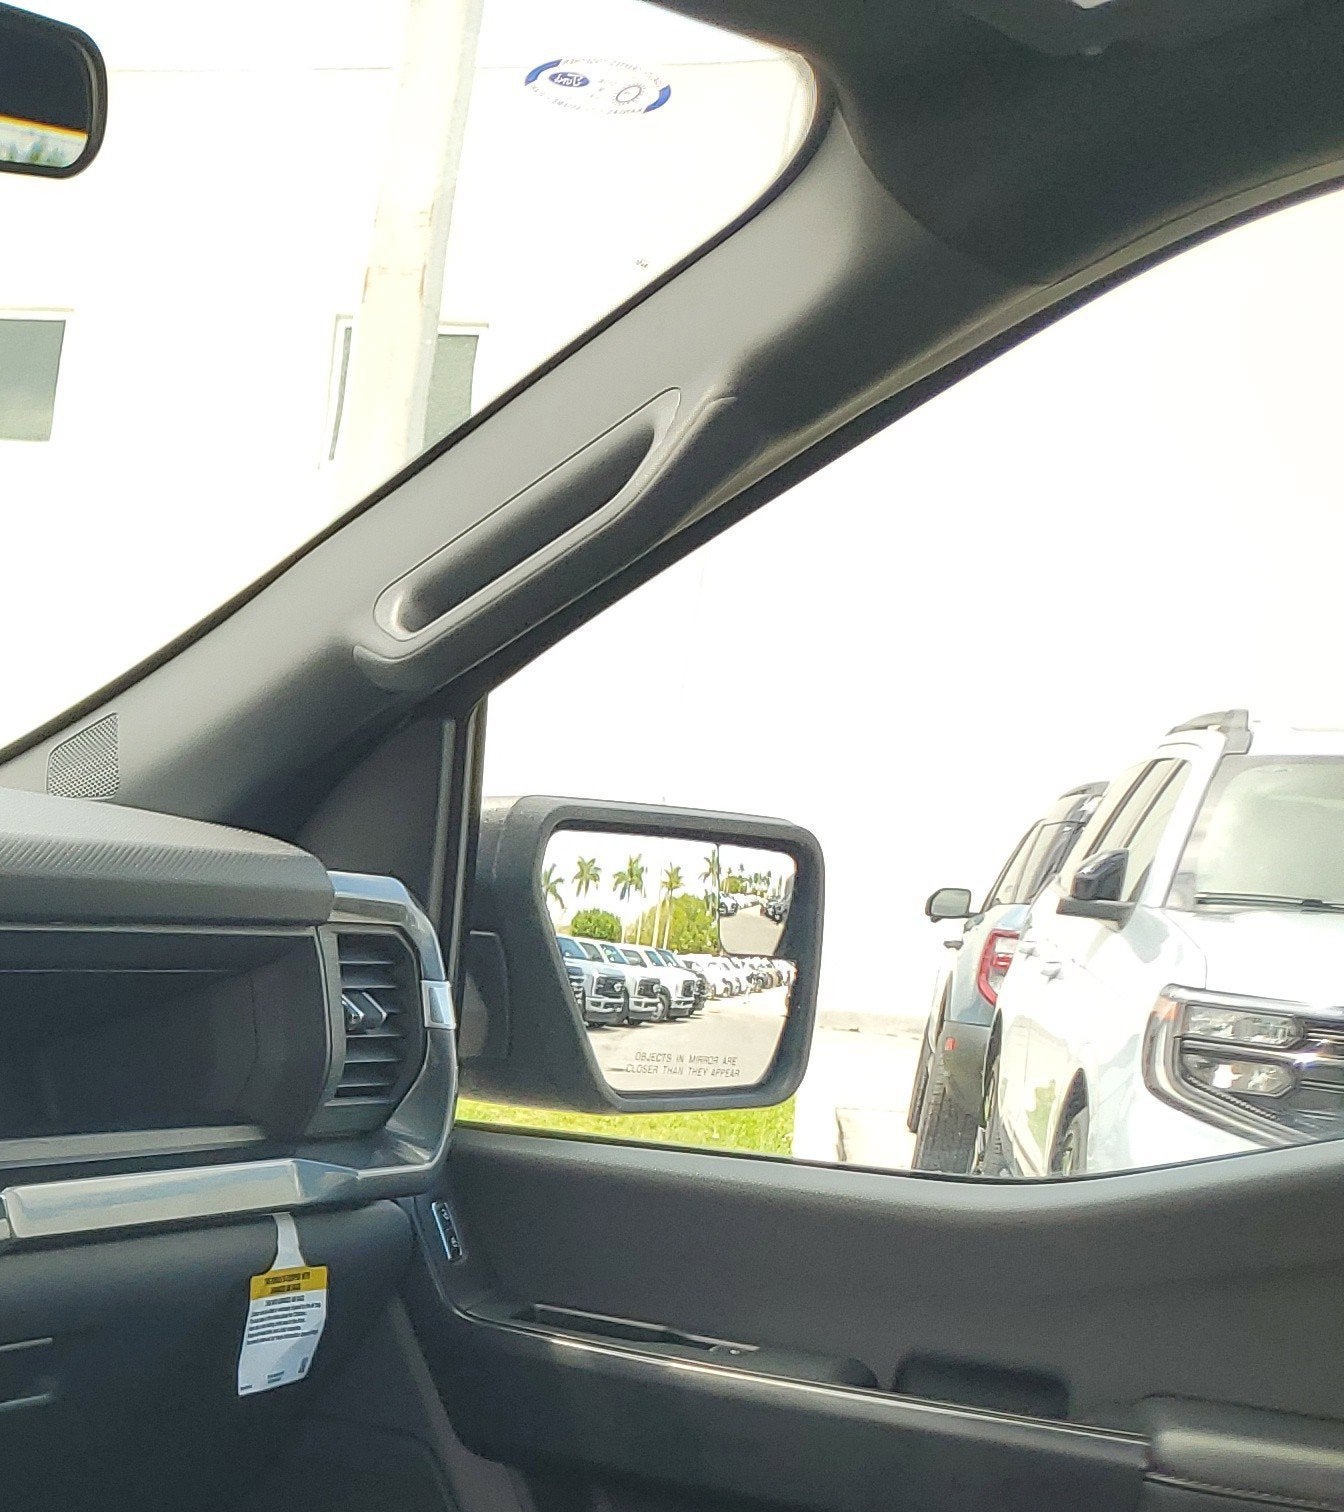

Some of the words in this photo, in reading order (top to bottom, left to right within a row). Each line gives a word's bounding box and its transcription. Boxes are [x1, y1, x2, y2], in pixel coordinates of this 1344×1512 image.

[634, 1051, 673, 1063] OBJECTS
[676, 1053, 685, 1064] IN
[688, 1054, 720, 1066] MIRROR
[723, 1056, 738, 1067] ARE
[625, 1063, 659, 1074] CLOSER
[663, 1065, 684, 1076] THAN
[688, 1066, 709, 1077] THEY
[710, 1067, 741, 1078] APPEAR
